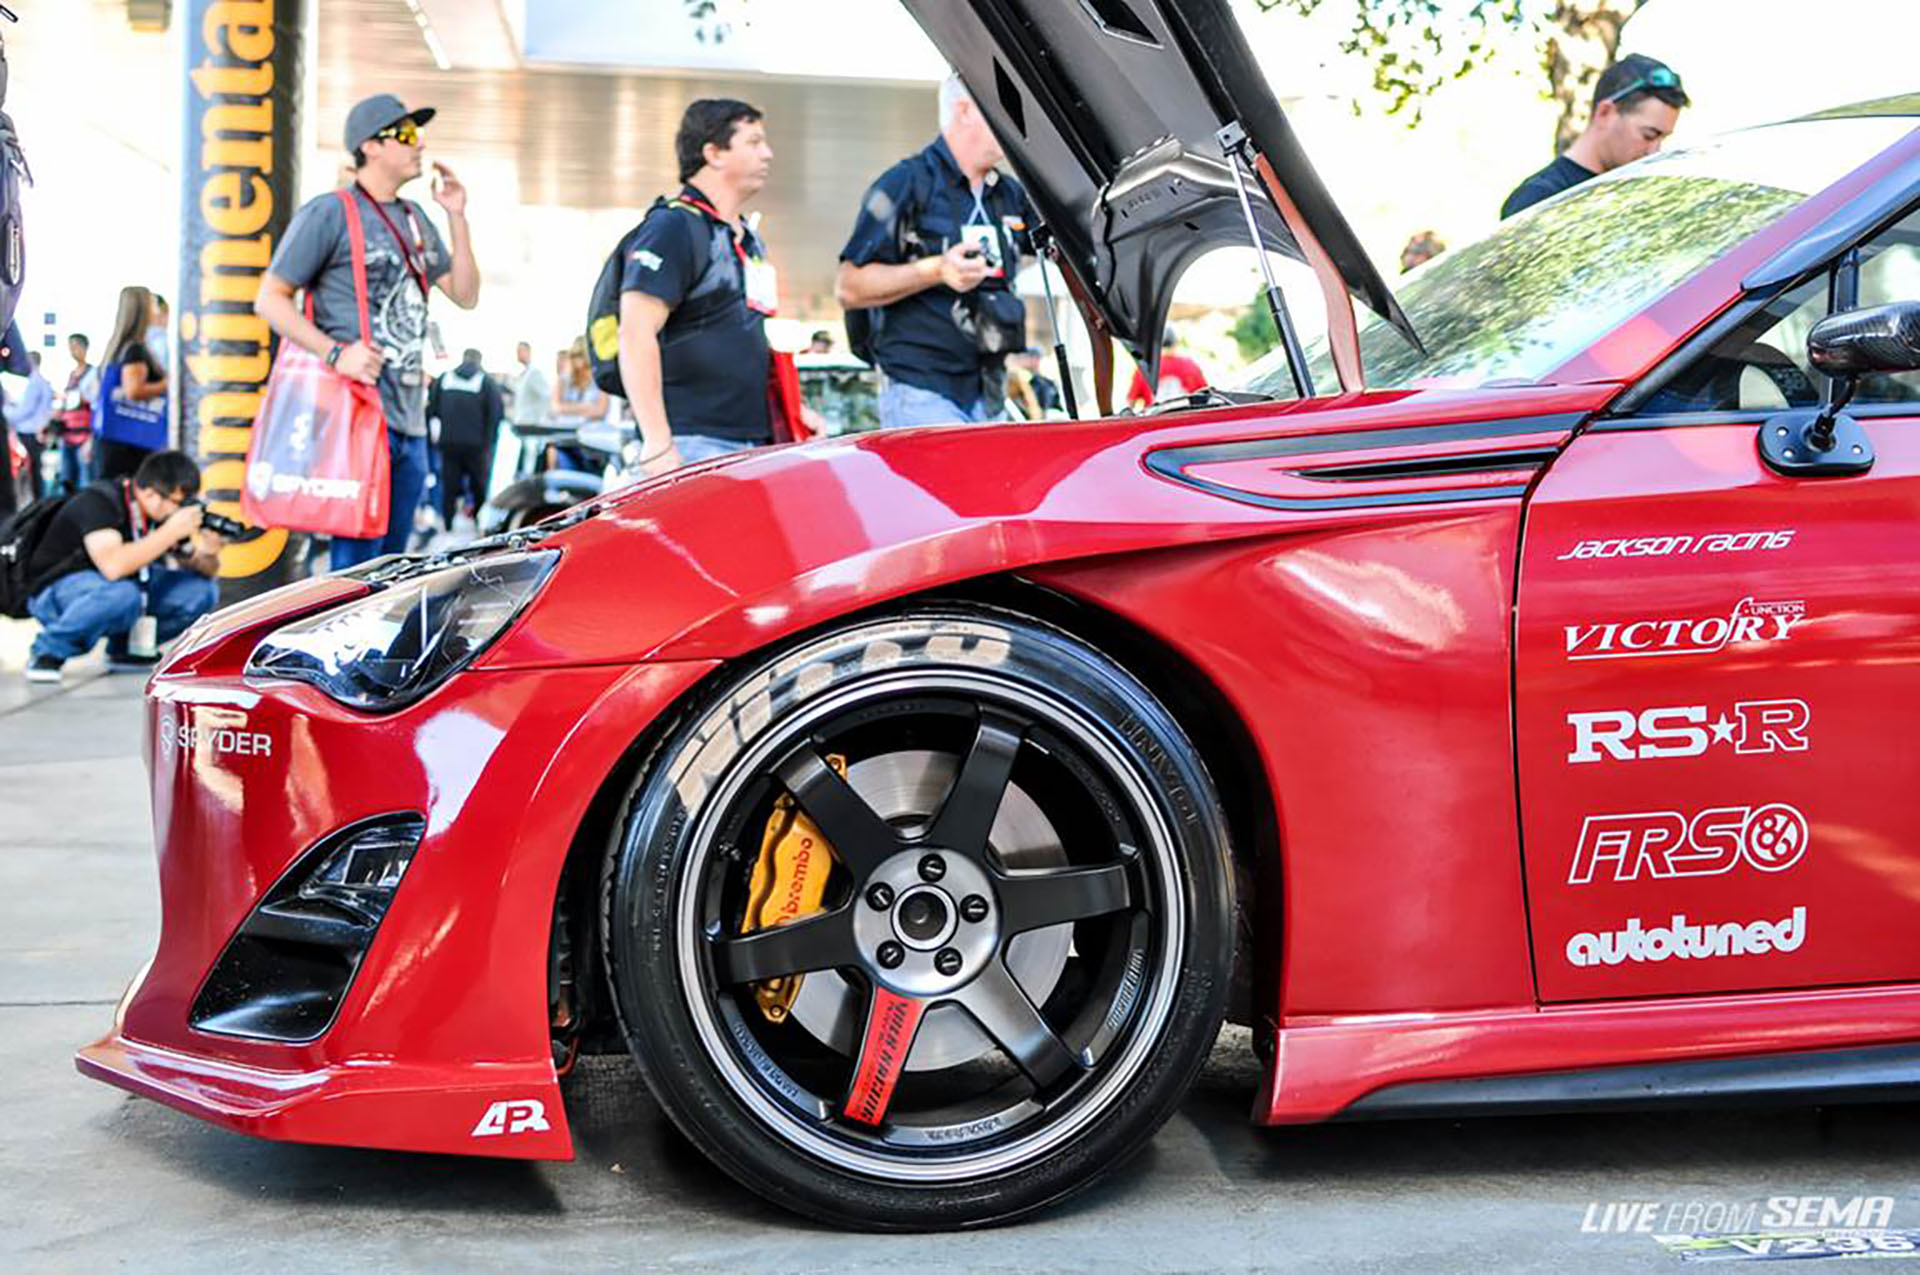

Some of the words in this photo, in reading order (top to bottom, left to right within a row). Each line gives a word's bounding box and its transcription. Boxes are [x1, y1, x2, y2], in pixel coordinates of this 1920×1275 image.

[1563, 612, 1804, 653] VICTORY
[177, 726, 272, 757] SPYDER
[780, 837, 813, 915] brembo
[1565, 906, 1807, 967] autotuned
